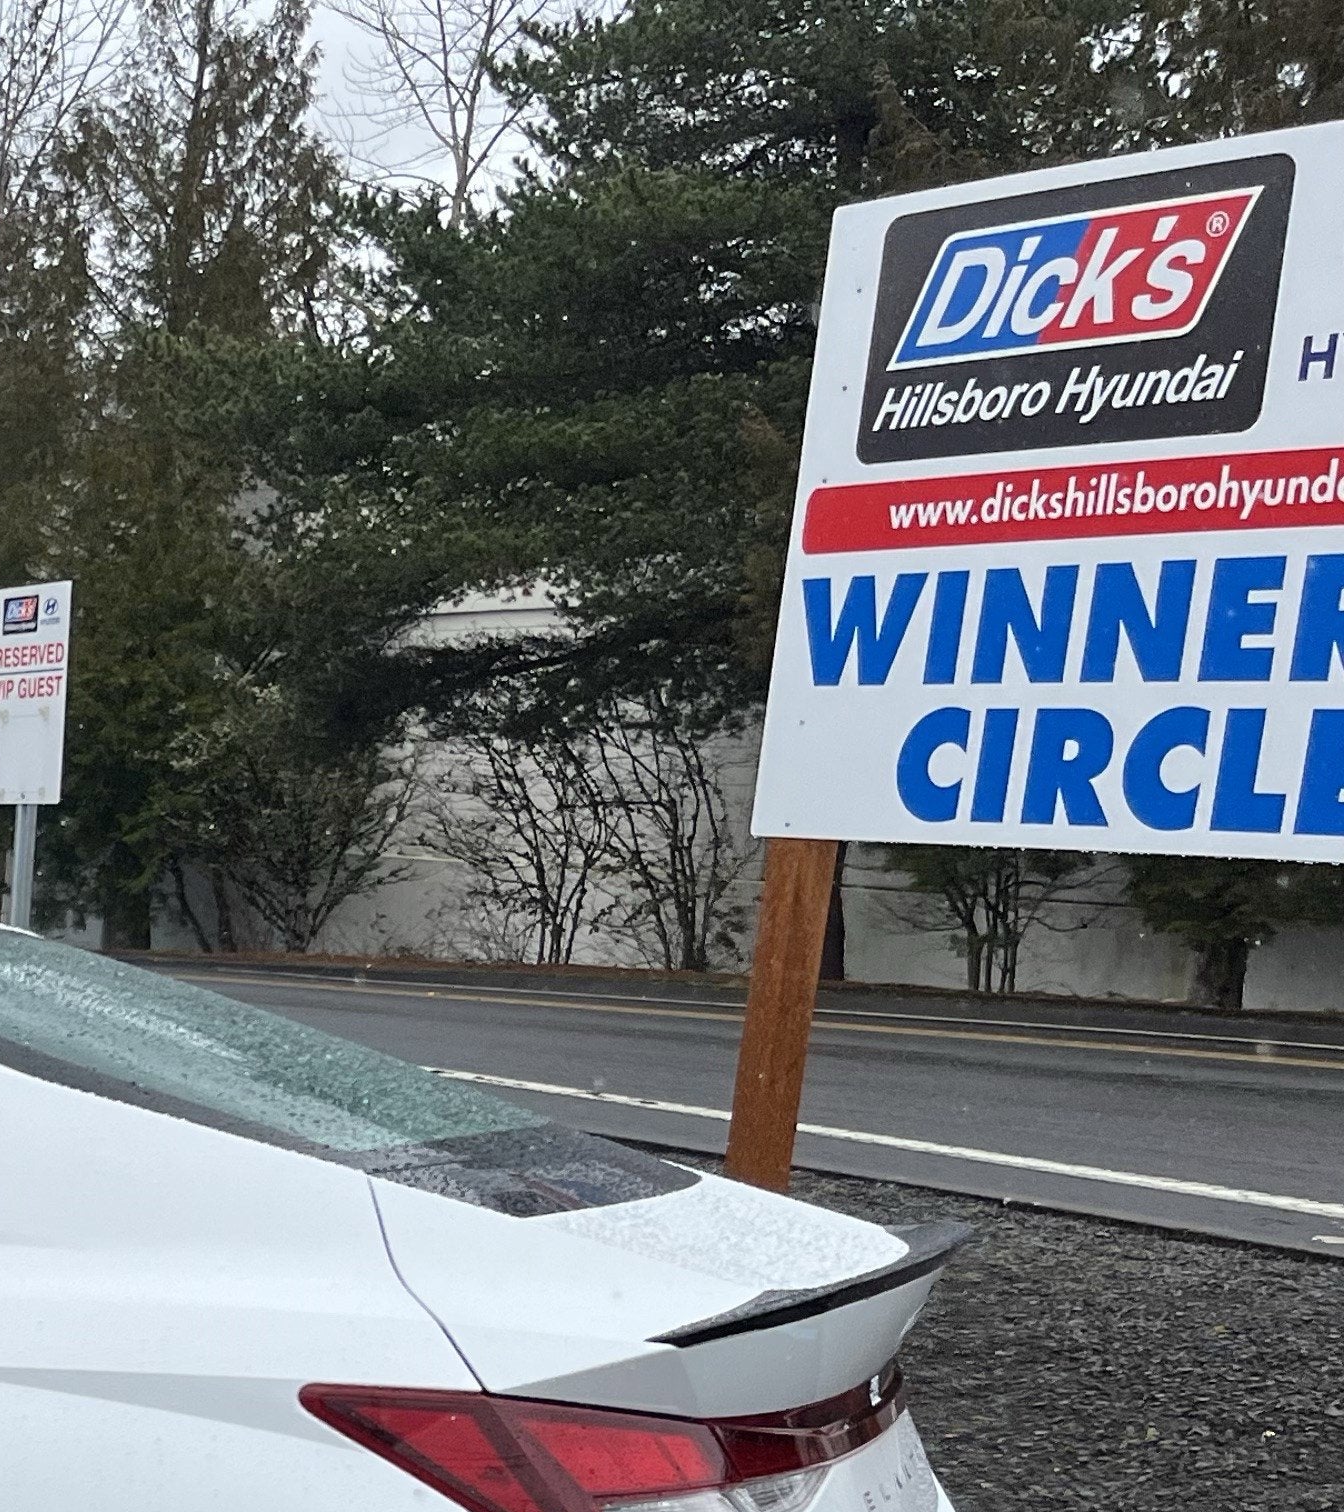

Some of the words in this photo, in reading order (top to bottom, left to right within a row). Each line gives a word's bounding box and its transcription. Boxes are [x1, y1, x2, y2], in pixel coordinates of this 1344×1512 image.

[916, 214, 1208, 348] Dick's
[1298, 332, 1344, 381] H
[872, 377, 1053, 433] Hillsboro
[1055, 350, 1245, 424] Hyundai
[17, 675, 63, 699] GUEST
